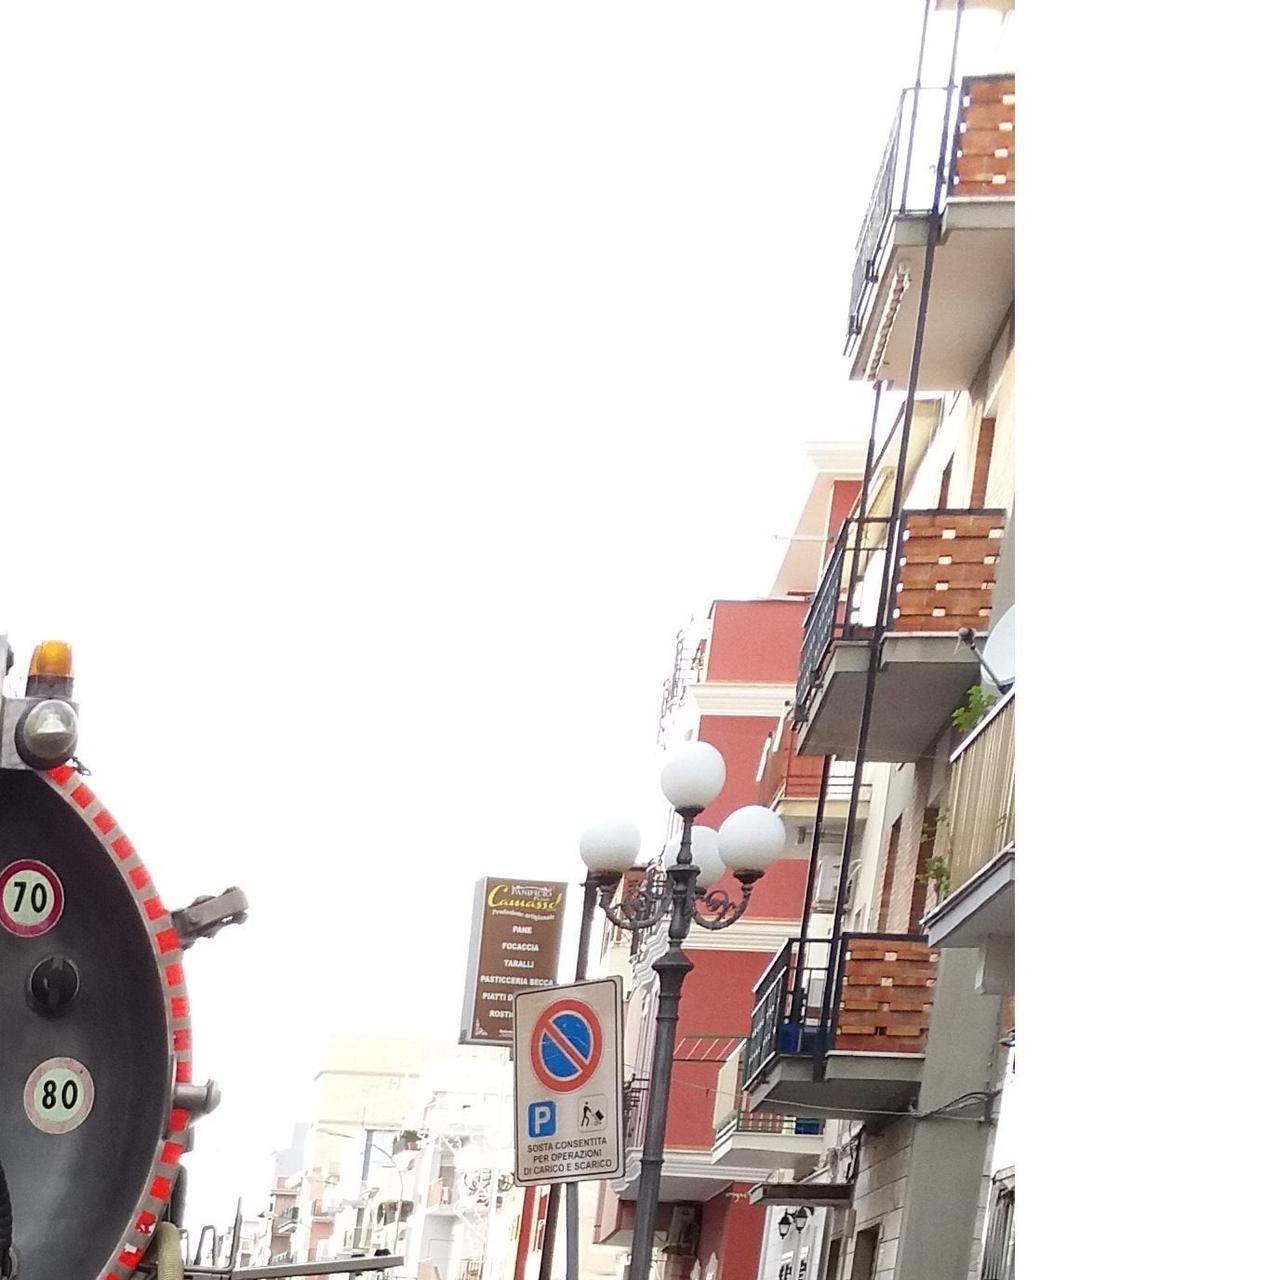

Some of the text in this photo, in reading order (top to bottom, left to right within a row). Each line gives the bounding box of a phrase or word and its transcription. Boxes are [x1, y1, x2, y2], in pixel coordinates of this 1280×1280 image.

[13, 881, 48, 914] 70
[512, 925, 533, 934] PANE
[502, 942, 539, 952] FOCACCIA
[503, 959, 535, 969] TARALLI
[480, 975, 554, 987] PASTICCERIA SECCA
[482, 992, 507, 1001] PIATTI
[41, 1079, 79, 1110] 80
[534, 1105, 551, 1134] P
[527, 1136, 607, 1153] SOSTA CONSENTITA
[533, 1148, 602, 1163] PER OPERAZIONI
[523, 1158, 612, 1176] DI CARICO E SCARICO
